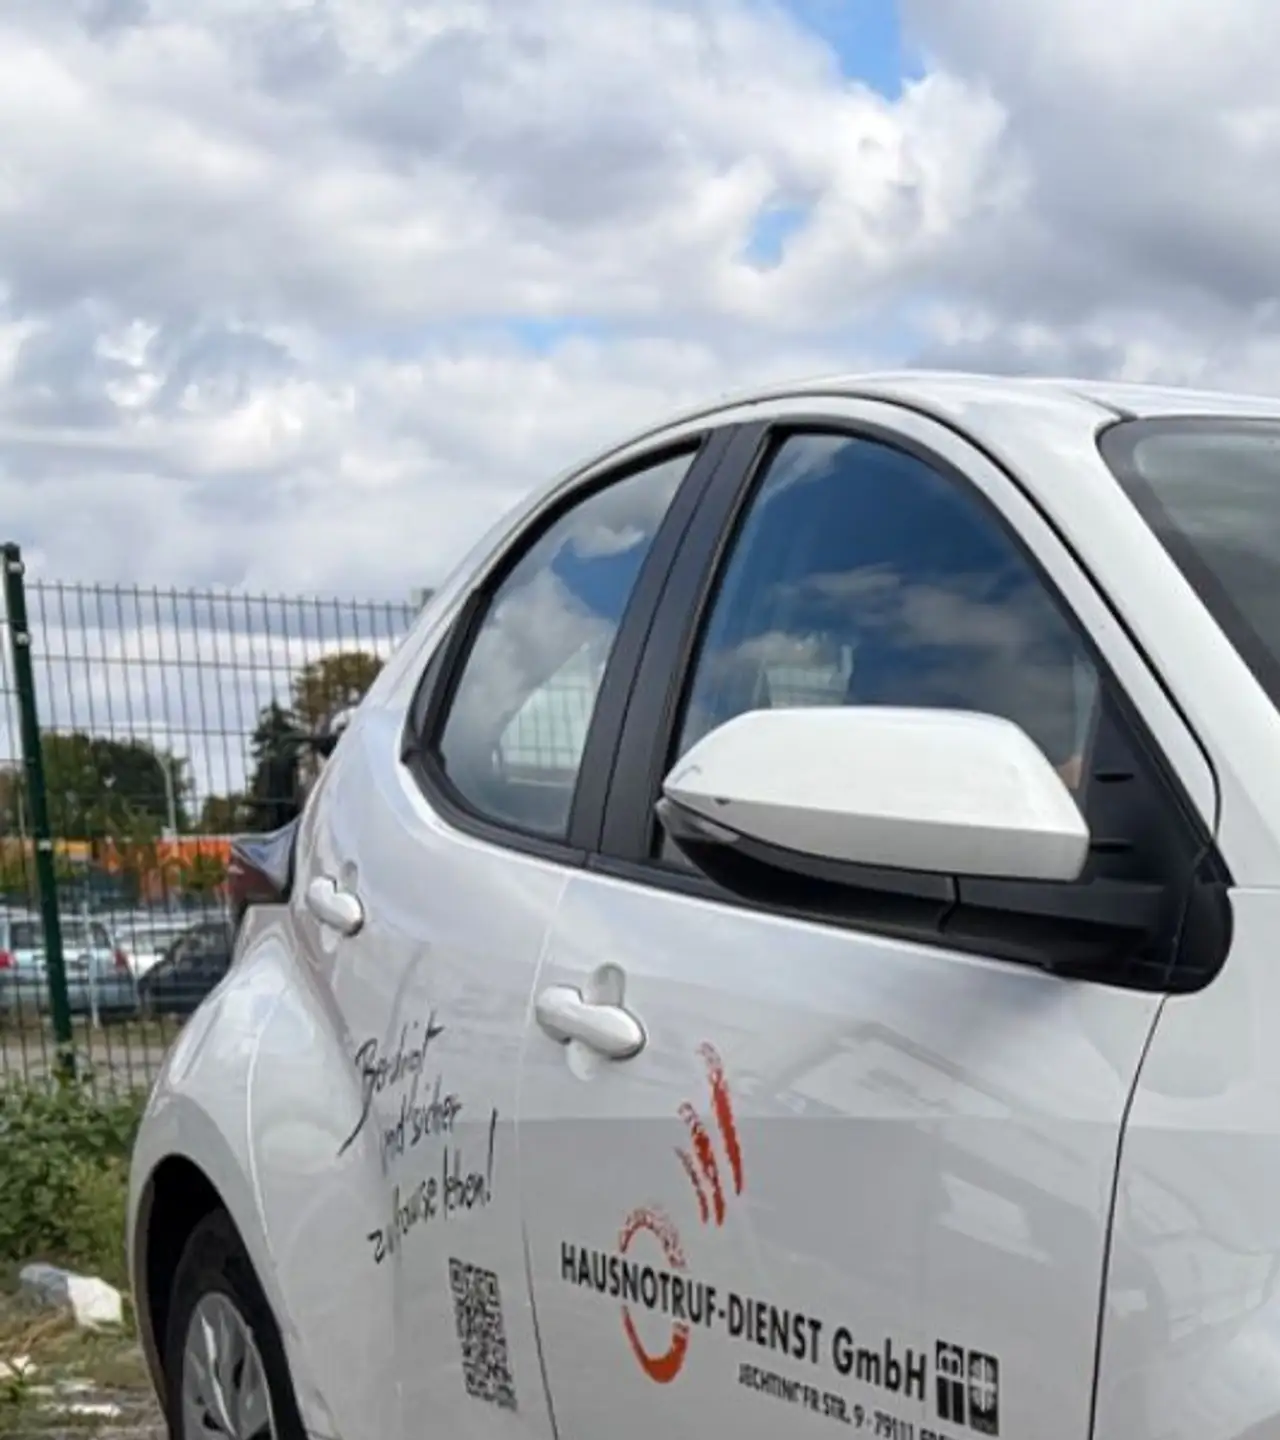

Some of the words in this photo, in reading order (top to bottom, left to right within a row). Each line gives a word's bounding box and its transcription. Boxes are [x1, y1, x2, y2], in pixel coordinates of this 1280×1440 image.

[560, 1241, 822, 1363] HAUSNOTRUF-DIENST
[832, 1326, 927, 1402] GmbH
[853, 1404, 865, 1429] 9
